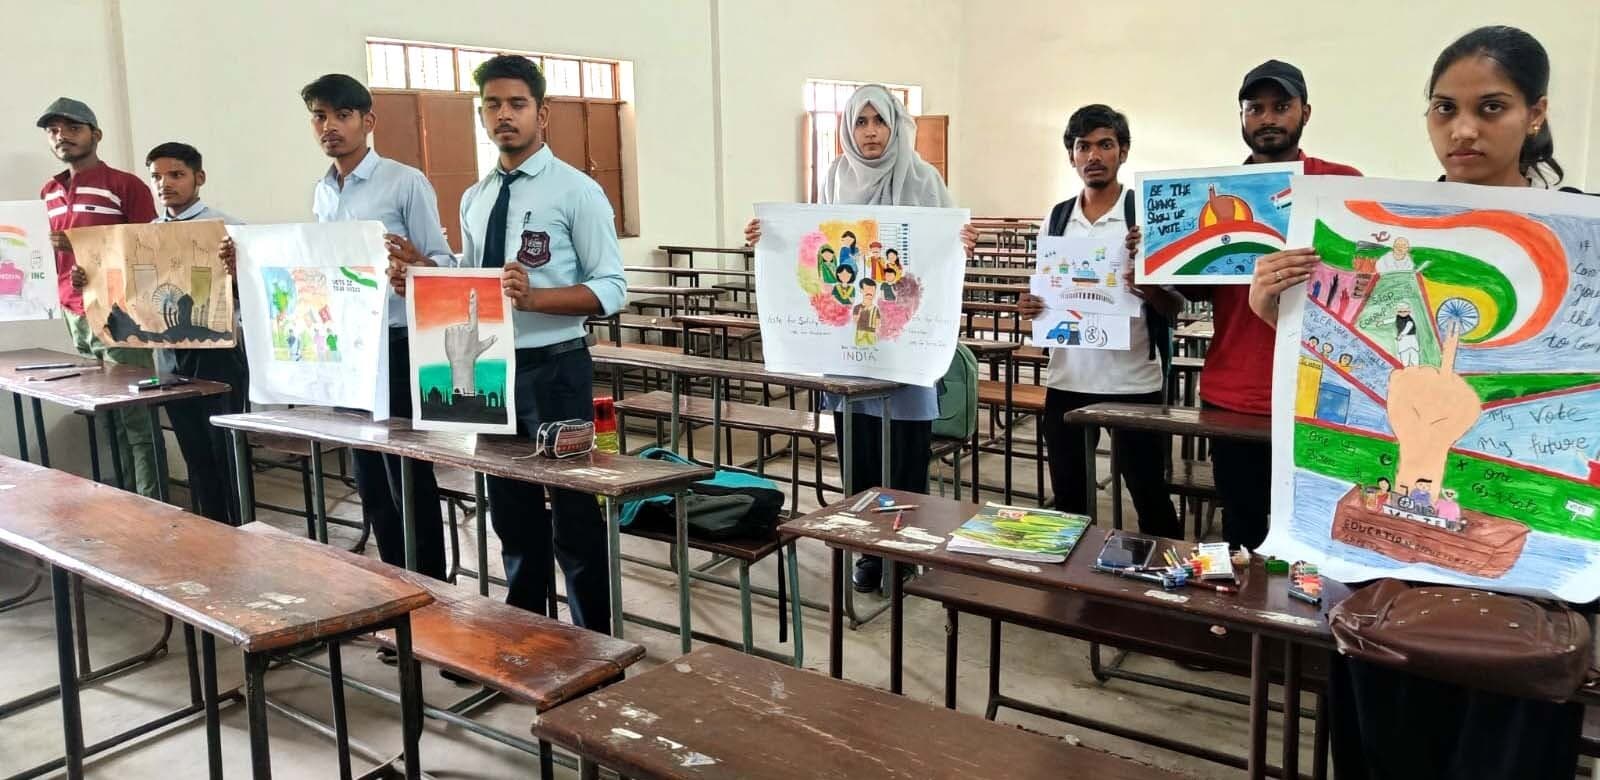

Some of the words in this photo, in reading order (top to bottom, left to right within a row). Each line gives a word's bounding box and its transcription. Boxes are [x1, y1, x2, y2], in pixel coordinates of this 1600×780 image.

[1150, 184, 1163, 197] BE
[1169, 183, 1191, 197] THE
[1174, 209, 1186, 219] UP
[1158, 222, 1181, 236] VOTE
[31, 272, 46, 280] INC
[842, 351, 877, 362] INDIA
[1488, 409, 1514, 431] My
[1529, 403, 1589, 424] Vote
[1478, 437, 1513, 458] My
[1529, 433, 1590, 465] future
